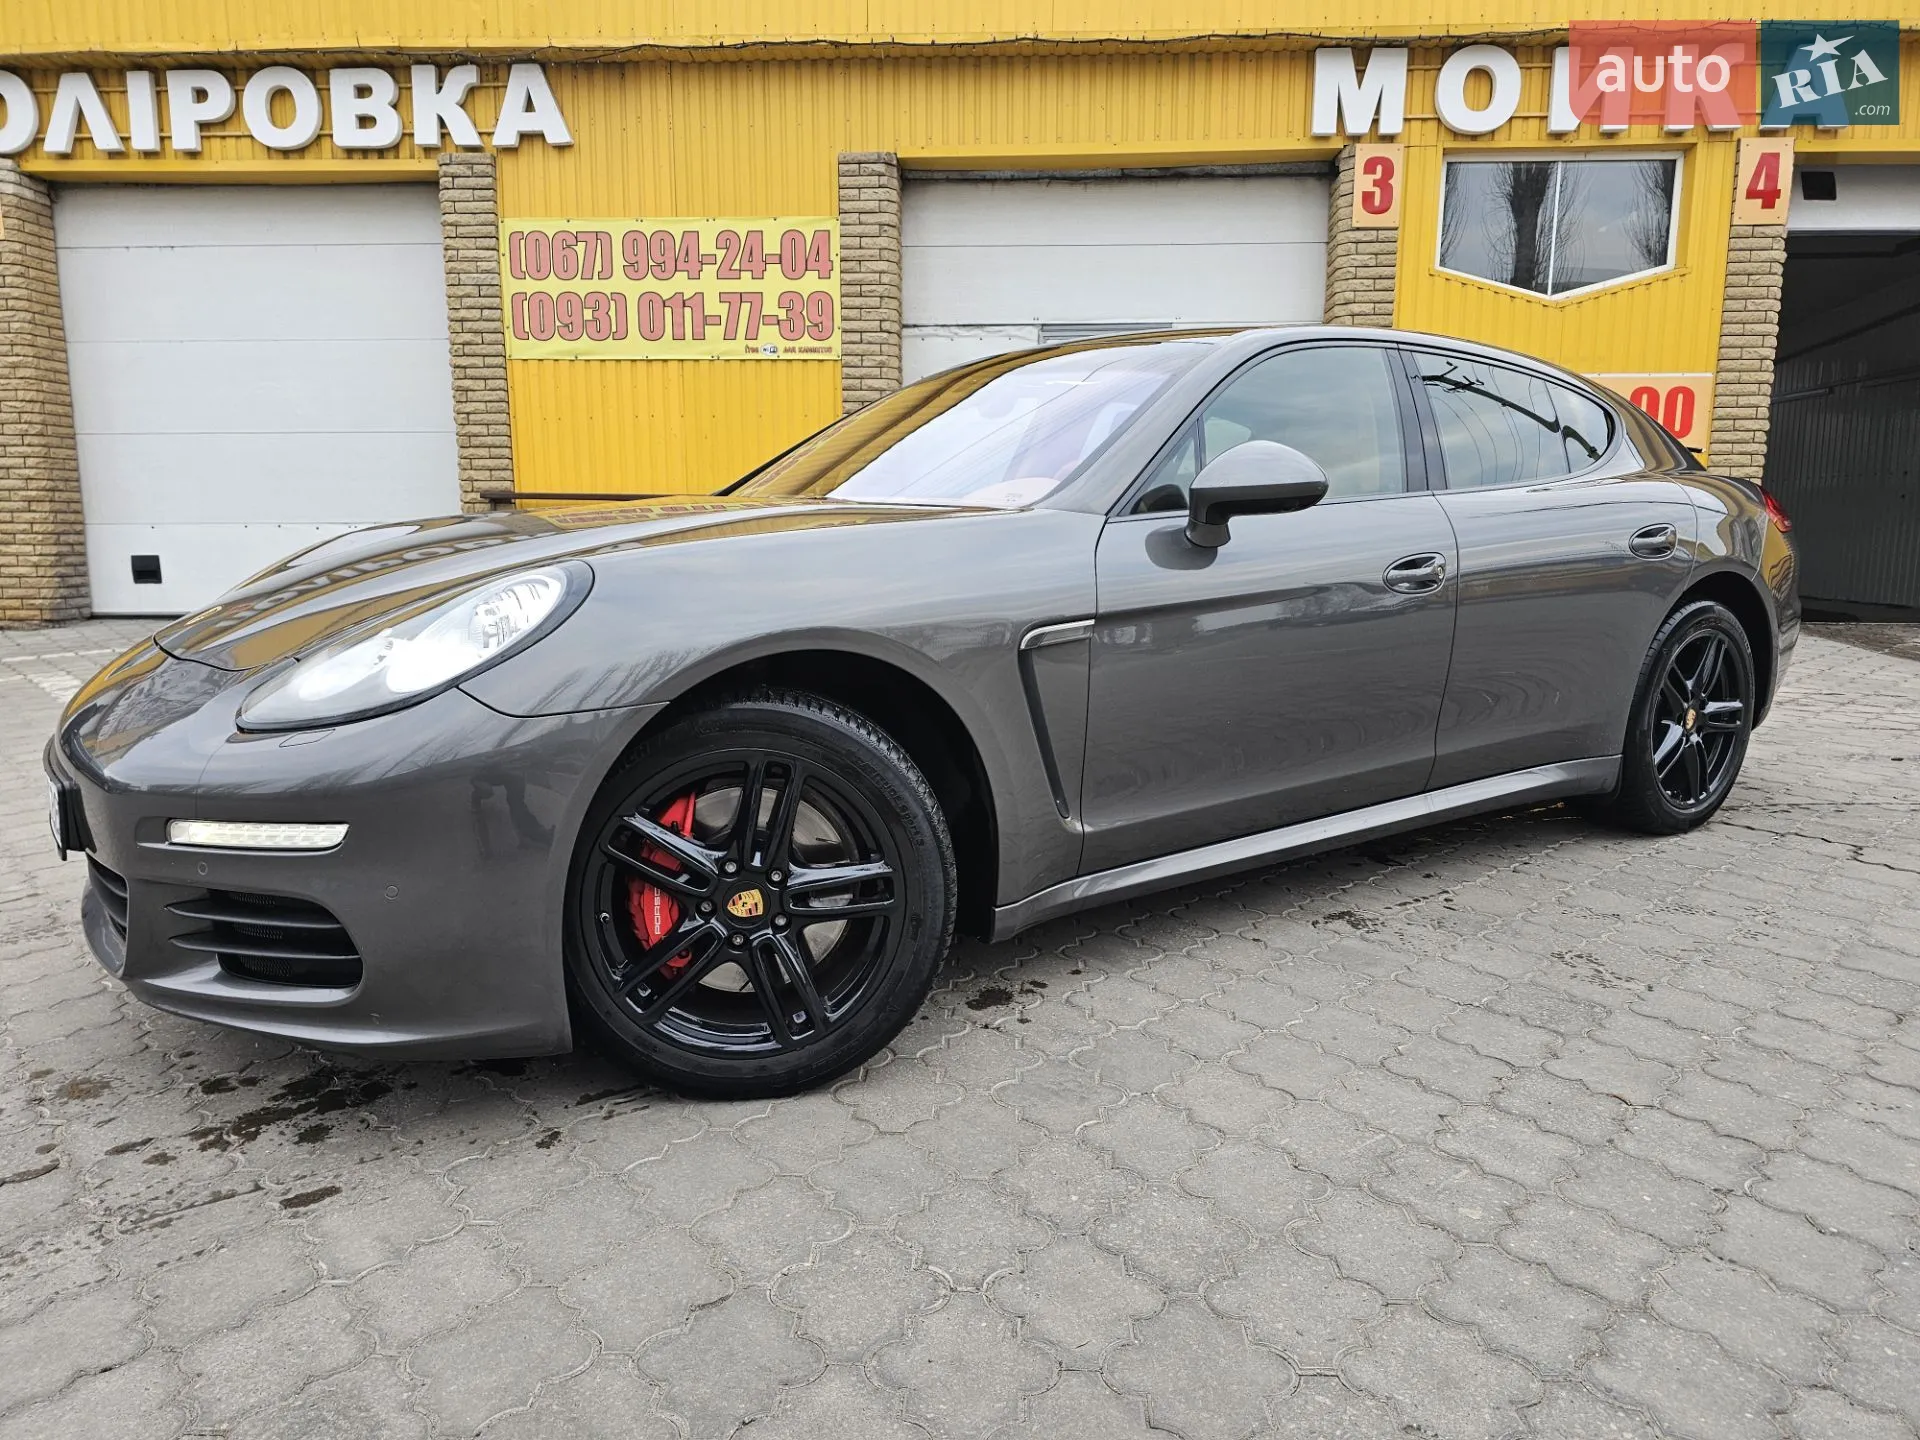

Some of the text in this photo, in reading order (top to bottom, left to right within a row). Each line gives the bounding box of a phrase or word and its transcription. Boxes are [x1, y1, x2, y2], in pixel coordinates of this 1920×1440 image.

[1361, 156, 1395, 215] 3
[1745, 152, 1782, 210] 4
[509, 229, 833, 280] (067) 994-24-04
[511, 290, 834, 341] (093) 011-77-39
